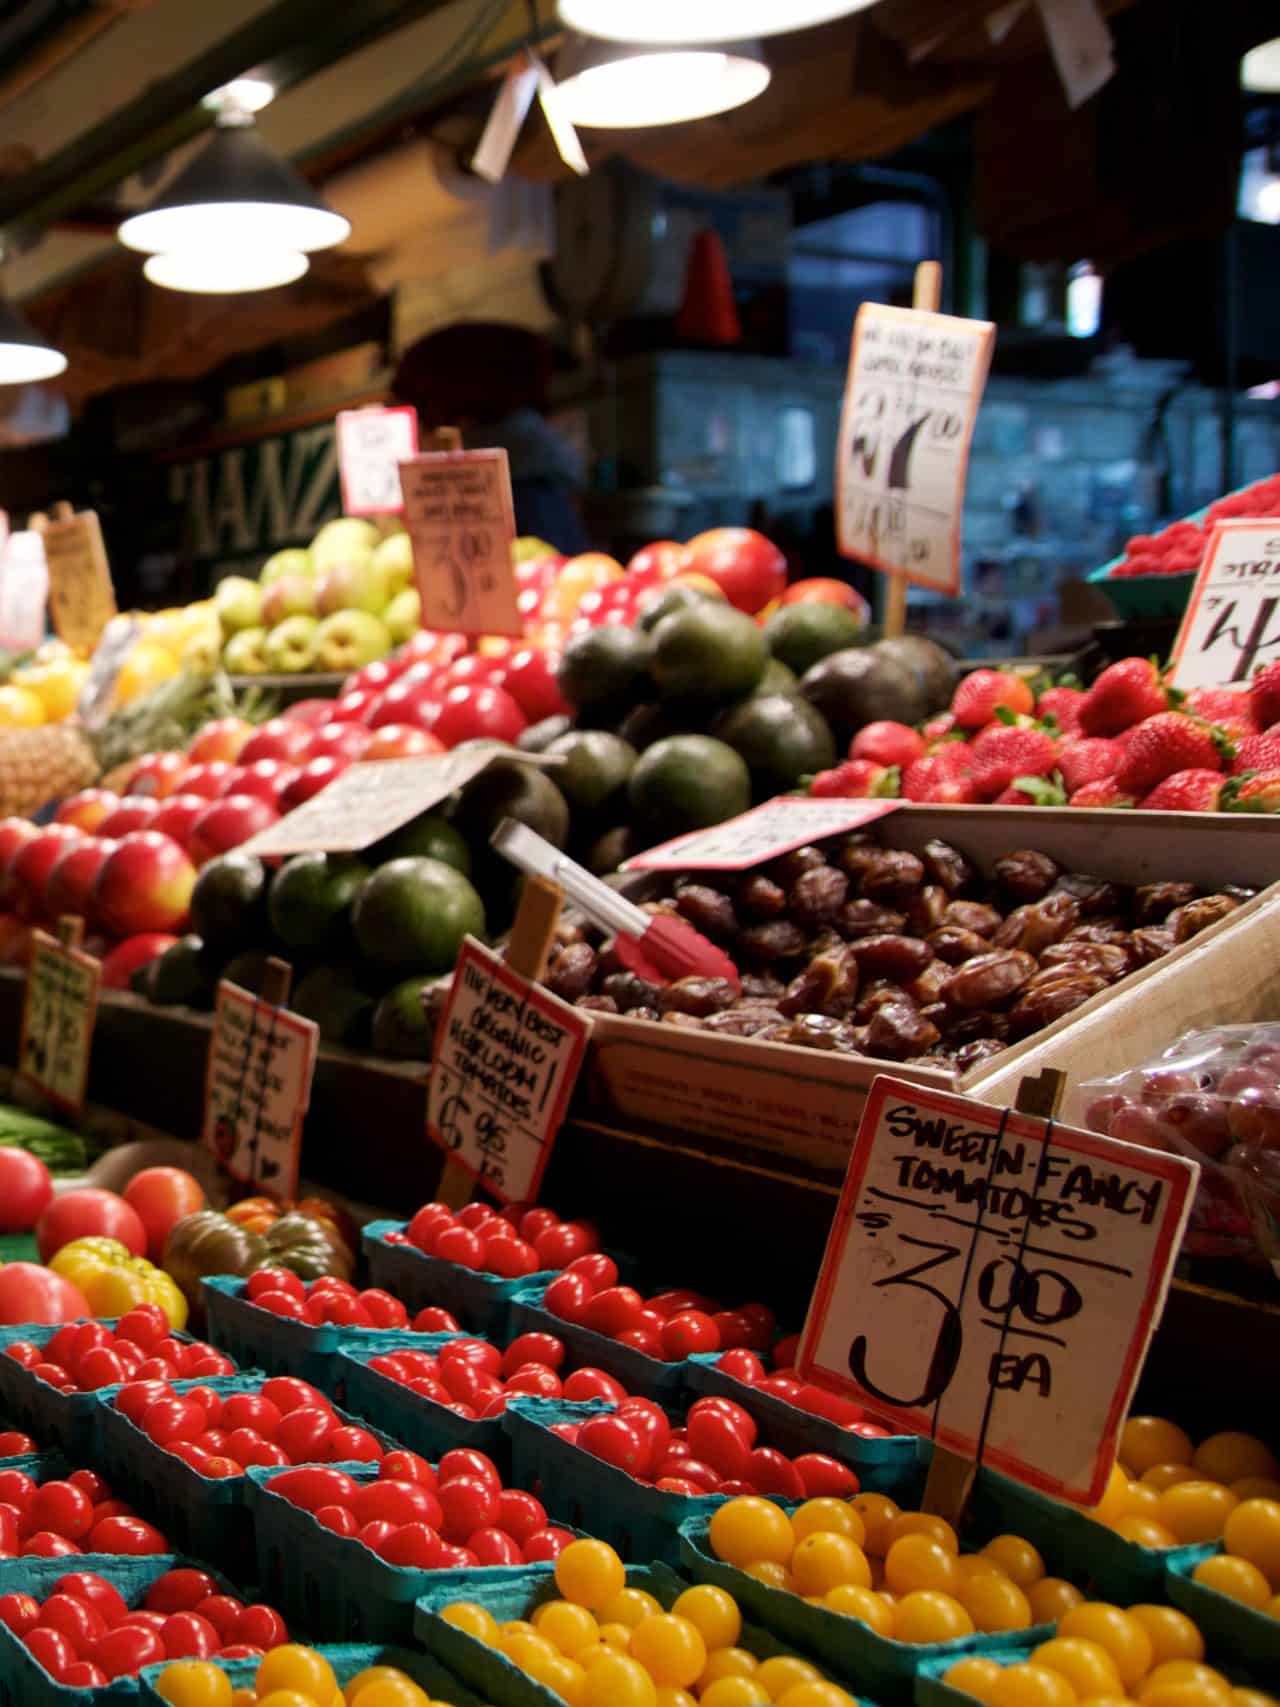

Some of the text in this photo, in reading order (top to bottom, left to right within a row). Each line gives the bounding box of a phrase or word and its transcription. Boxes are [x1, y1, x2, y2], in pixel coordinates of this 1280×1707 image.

[449, 1017, 538, 1093] HEIRLOOM
[471, 1006, 546, 1065] ORGANIC
[524, 1009, 571, 1048] BEST
[893, 1155, 1098, 1241] TOMATOES
[987, 1351, 1051, 1398] EA
